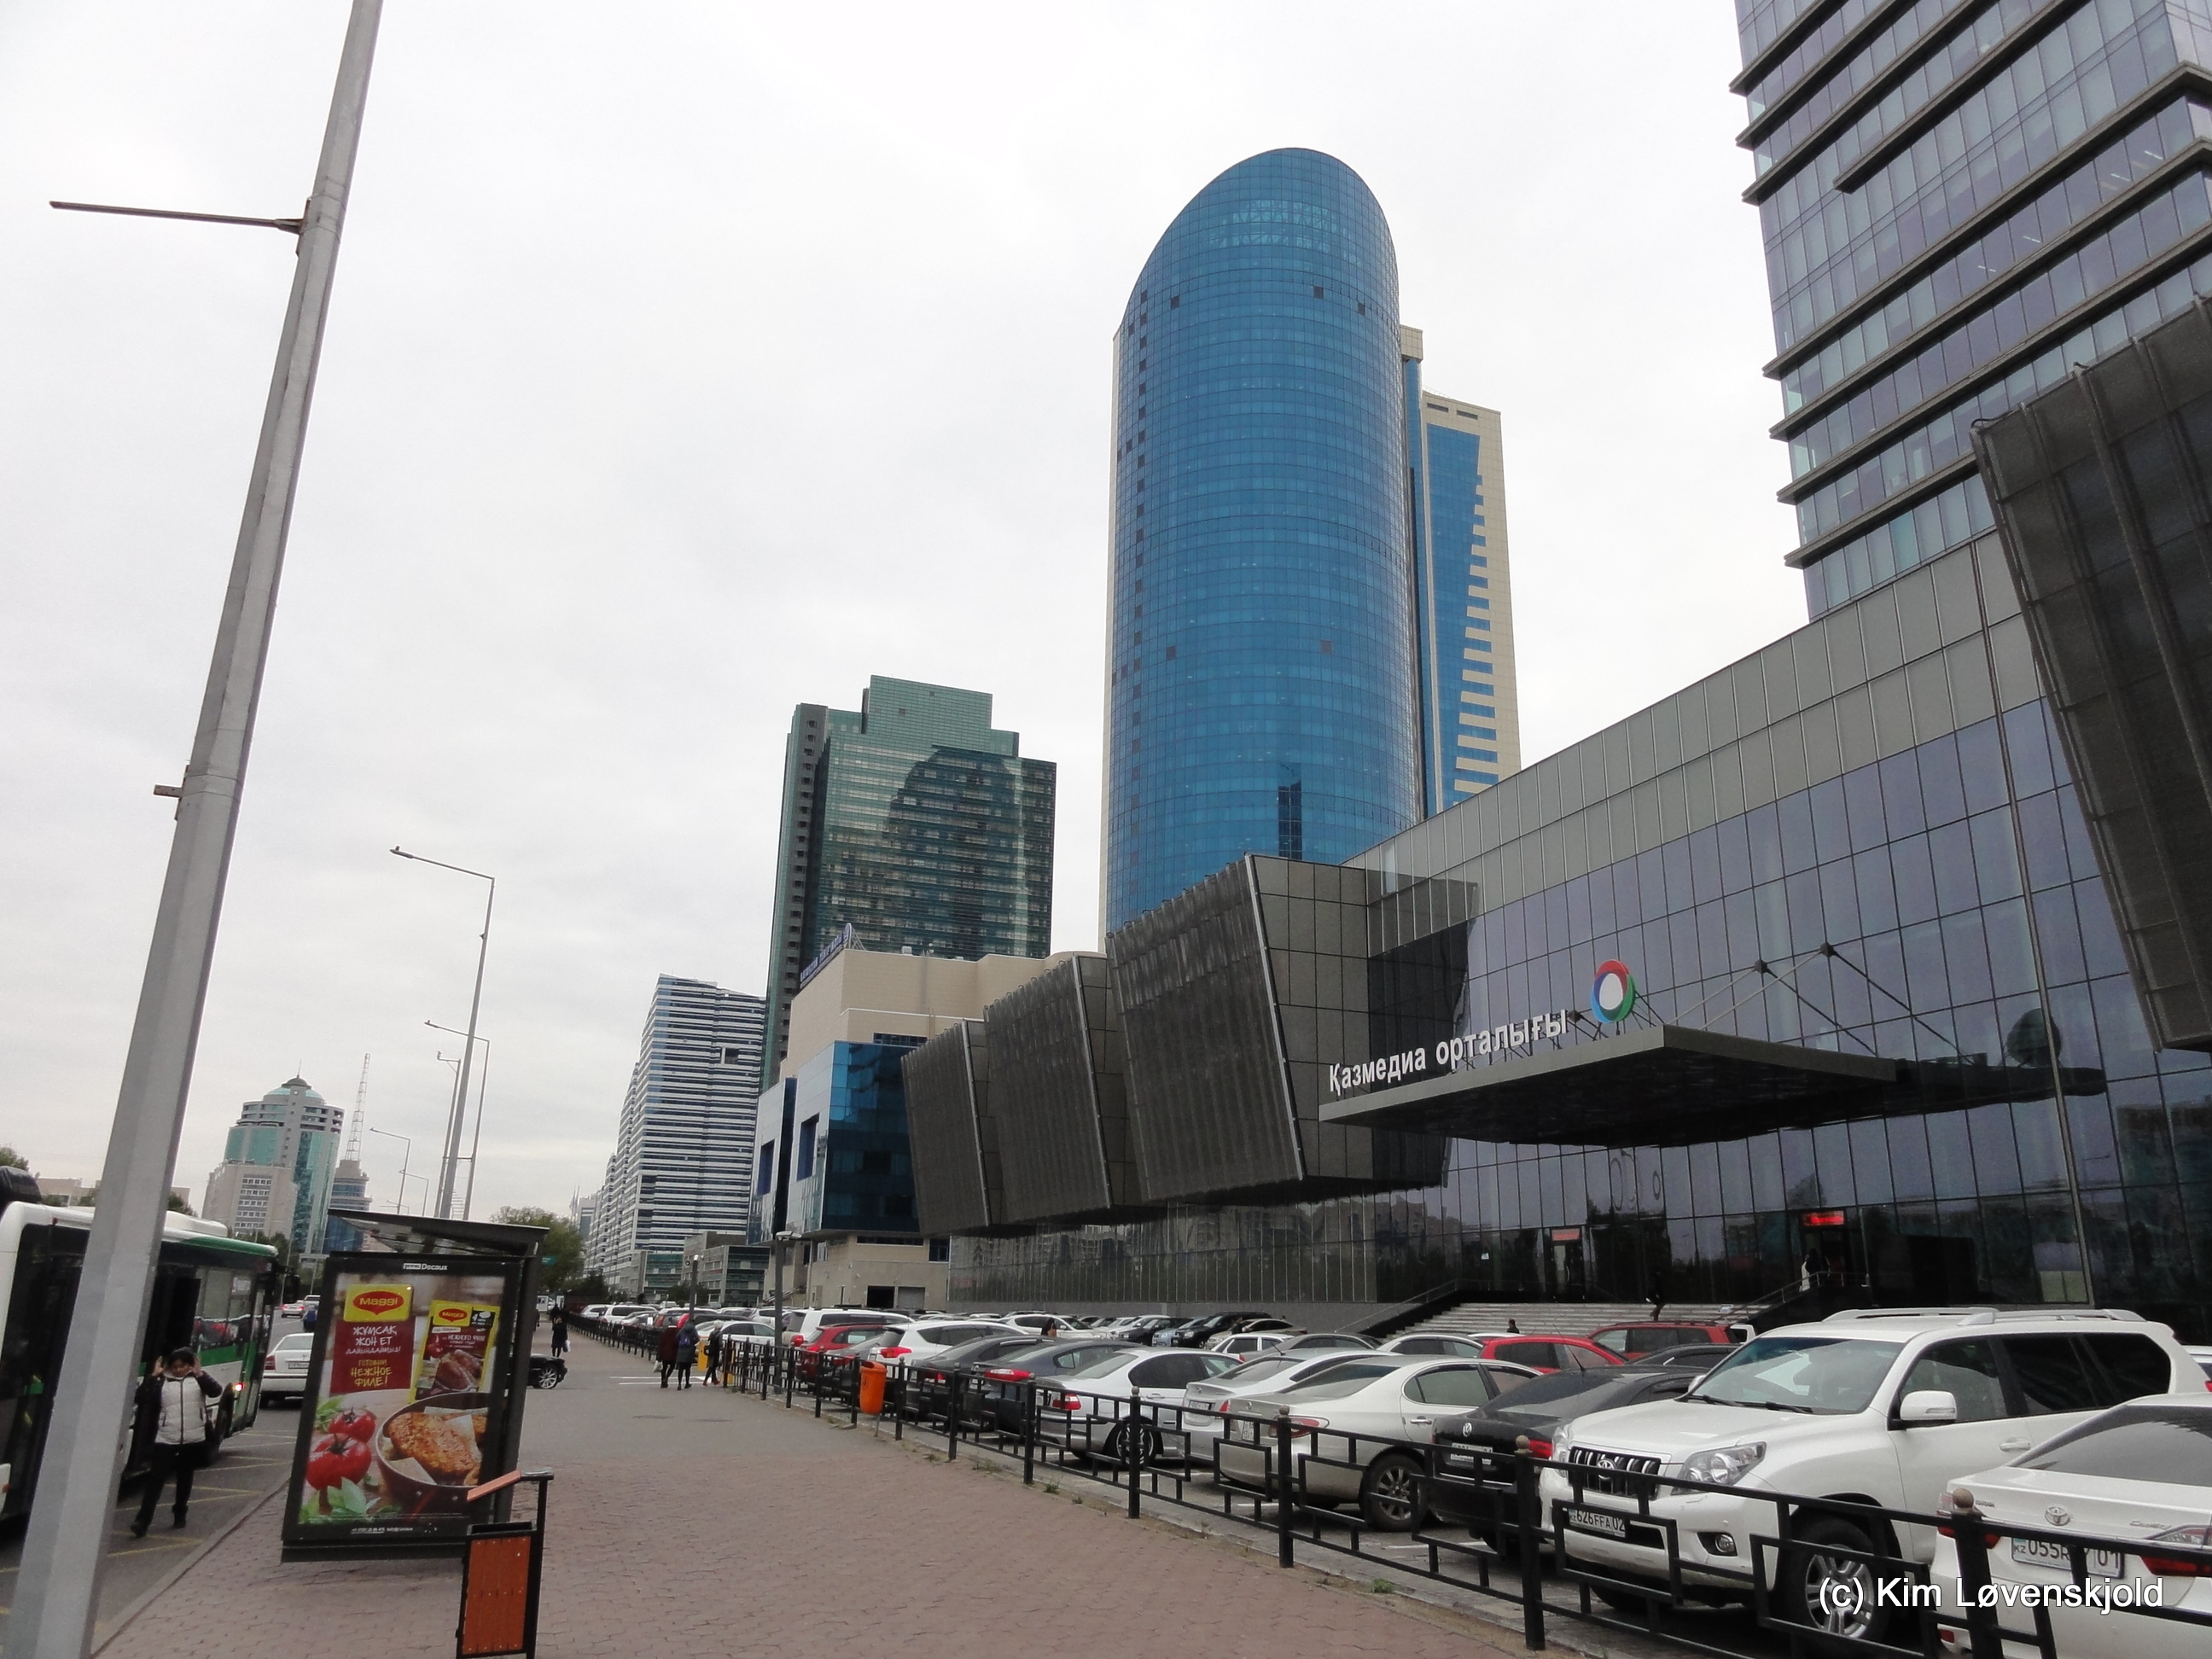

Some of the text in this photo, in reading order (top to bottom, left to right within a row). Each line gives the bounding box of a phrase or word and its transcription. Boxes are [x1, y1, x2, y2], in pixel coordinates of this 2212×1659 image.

[1330, 1009, 1568, 1096] Қазмедиа орталығы
[359, 1297, 399, 1307] Maggi
[351, 1366, 393, 1377] НЕЖНОЕ
[354, 1376, 388, 1387] ФИЛЕ!
